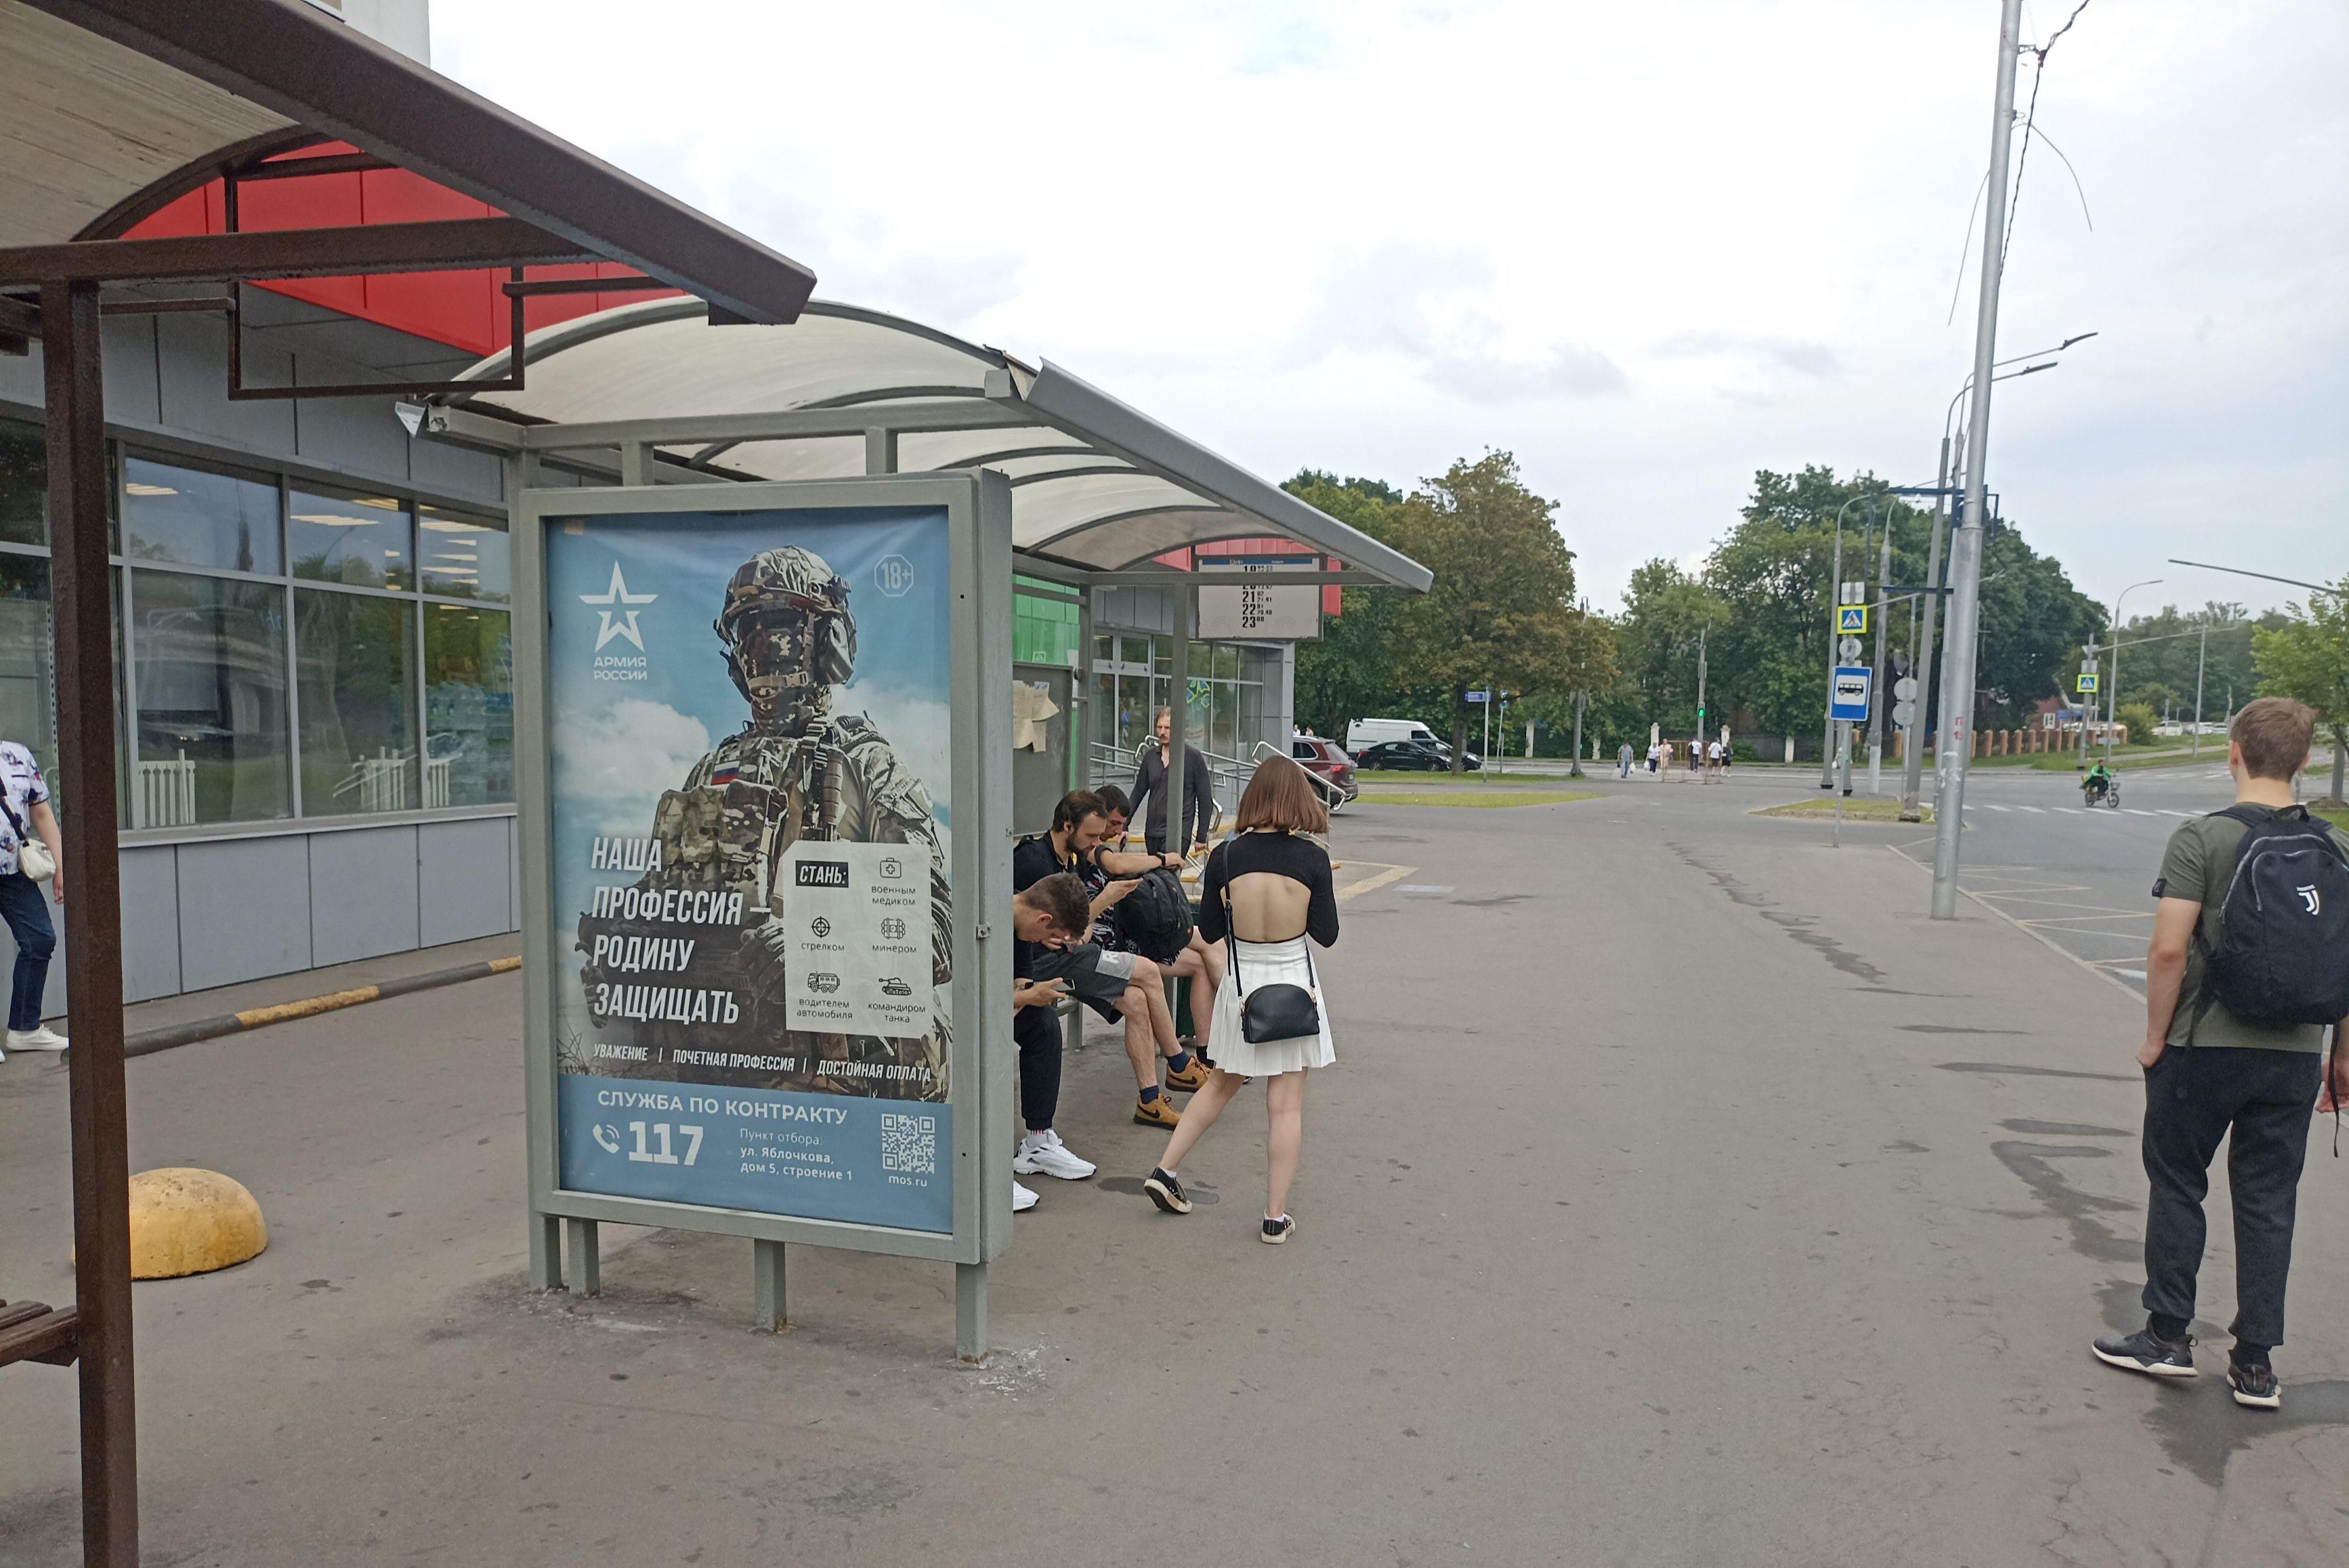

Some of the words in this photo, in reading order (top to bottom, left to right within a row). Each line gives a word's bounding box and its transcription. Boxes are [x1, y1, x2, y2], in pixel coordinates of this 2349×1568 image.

[881, 562, 911, 589] 18+
[1242, 591, 1254, 603] 21
[1242, 603, 1256, 616] 22
[1242, 616, 1256, 628] 23
[593, 656, 647, 667] АРМИЯ
[593, 671, 648, 681] РОССИИ
[591, 837, 662, 872] НАША
[799, 865, 847, 884] СТАНЬ:
[871, 886, 916, 895] военным
[591, 886, 744, 925] ПРОФЕССИЯ
[872, 898, 916, 906] медиком
[801, 942, 845, 952] стрелком
[872, 945, 917, 954] минером
[593, 935, 695, 973] РОДИНУ
[593, 983, 740, 1025] ЗАЩИЩАТЬ
[799, 999, 849, 1008] водителем
[868, 1003, 926, 1014] командиром
[797, 1010, 853, 1019] автомобиля
[885, 1015, 910, 1023] танка
[593, 1043, 648, 1061] УВАЖЕНИЕ
[673, 1048, 727, 1067] ПОЧЕТНАЯ
[729, 1053, 795, 1072] ПРОФЕССИЯ
[817, 1057, 884, 1079] ДОСТОЙНАЯ
[886, 1065, 931, 1082] ОПЛАТА
[597, 1090, 683, 1112] СЛУЖБА
[690, 1097, 719, 1114] ПО
[725, 1100, 848, 1125] КОНТРАКТУ
[740, 1128, 774, 1143] Пункт
[778, 1130, 823, 1146] отбора:
[629, 1121, 704, 1166] 117
[740, 1147, 758, 1159] ул.
[761, 1147, 834, 1165] Яблочкова,
[740, 1164, 766, 1173] дом
[769, 1163, 780, 1176] 5,
[782, 1167, 843, 1181] строение
[847, 1170, 853, 1181] 1
[888, 1175, 928, 1187] mos.ru
